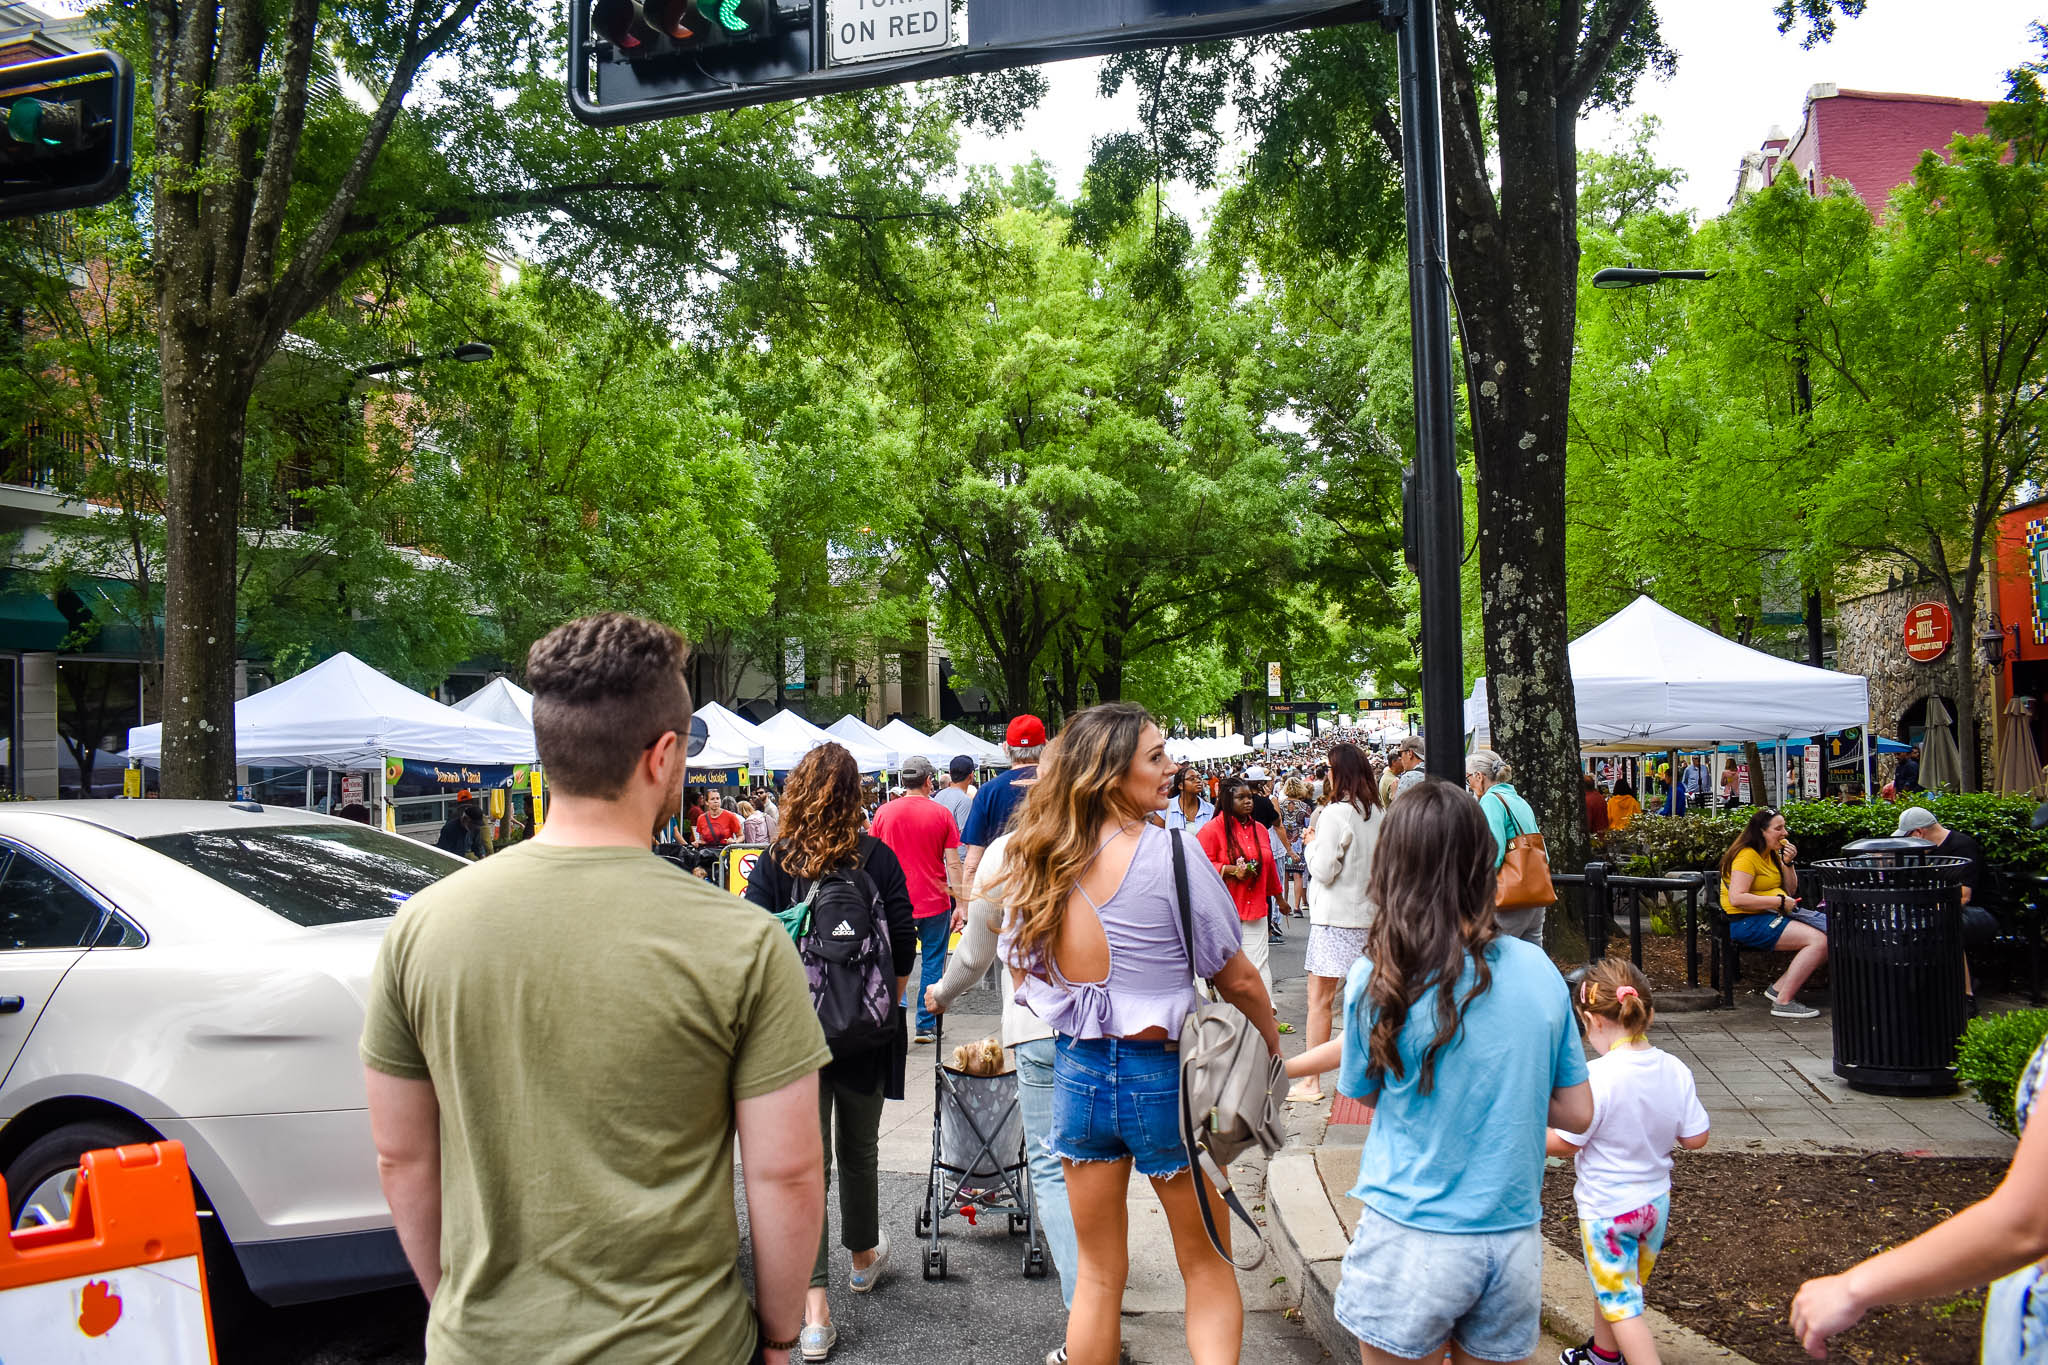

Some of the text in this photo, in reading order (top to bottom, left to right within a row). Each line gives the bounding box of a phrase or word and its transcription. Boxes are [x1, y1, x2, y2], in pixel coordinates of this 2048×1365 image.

[841, 11, 938, 44] ON RED
[832, 928, 855, 936] adidas
